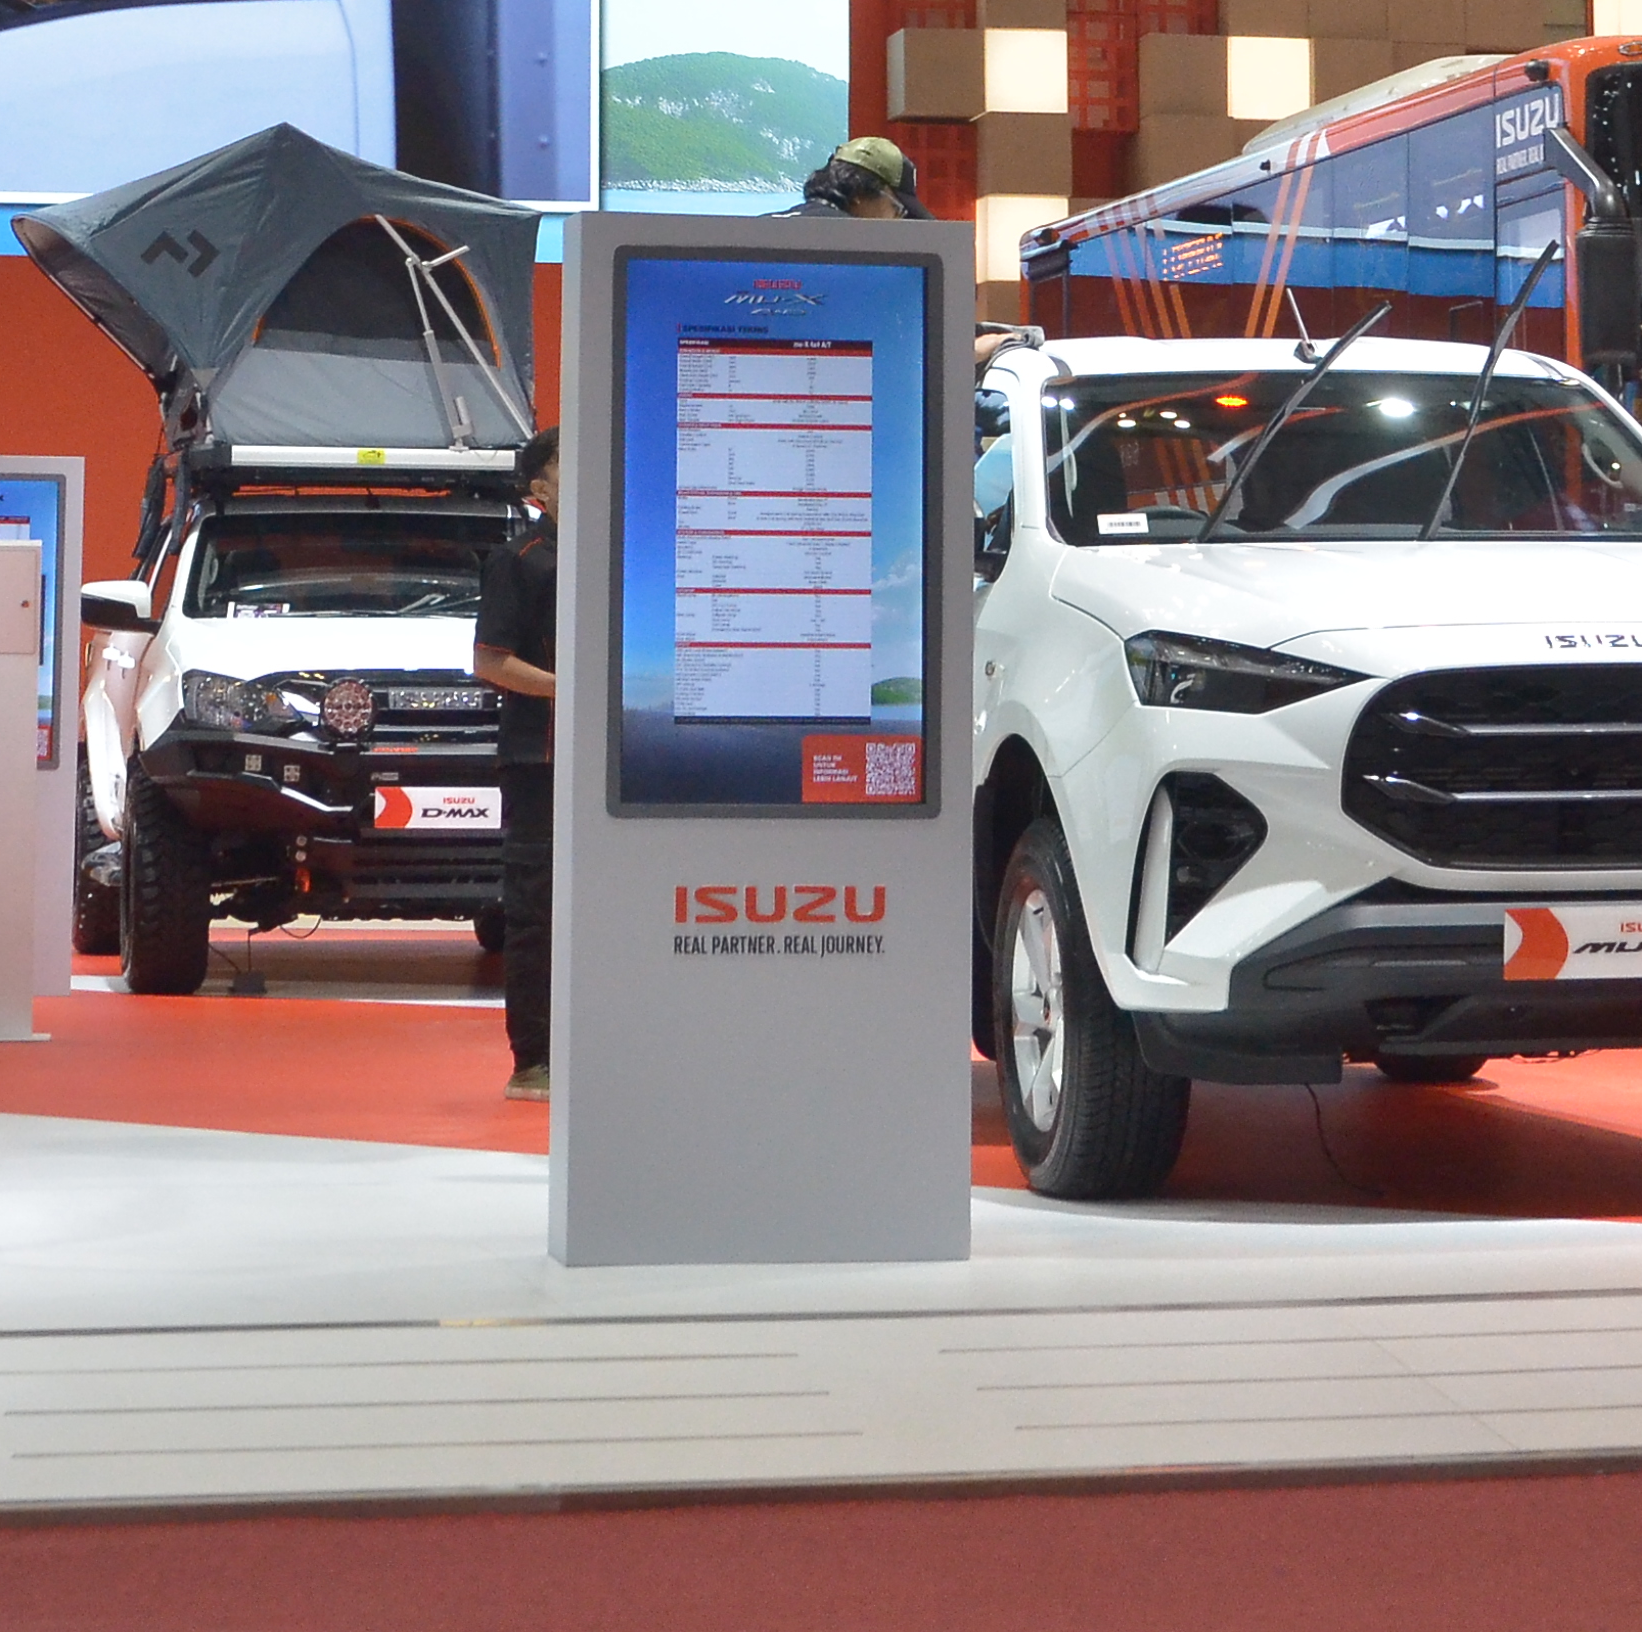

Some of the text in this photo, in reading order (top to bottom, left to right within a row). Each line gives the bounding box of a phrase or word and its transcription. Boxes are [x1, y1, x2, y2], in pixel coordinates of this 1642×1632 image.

[1496, 93, 1559, 149] ISUZU
[421, 808, 489, 818] D-MAX
[674, 885, 886, 923] ISUZU
[674, 935, 885, 958] REAL PARTNER. REAL JOURNEY.
